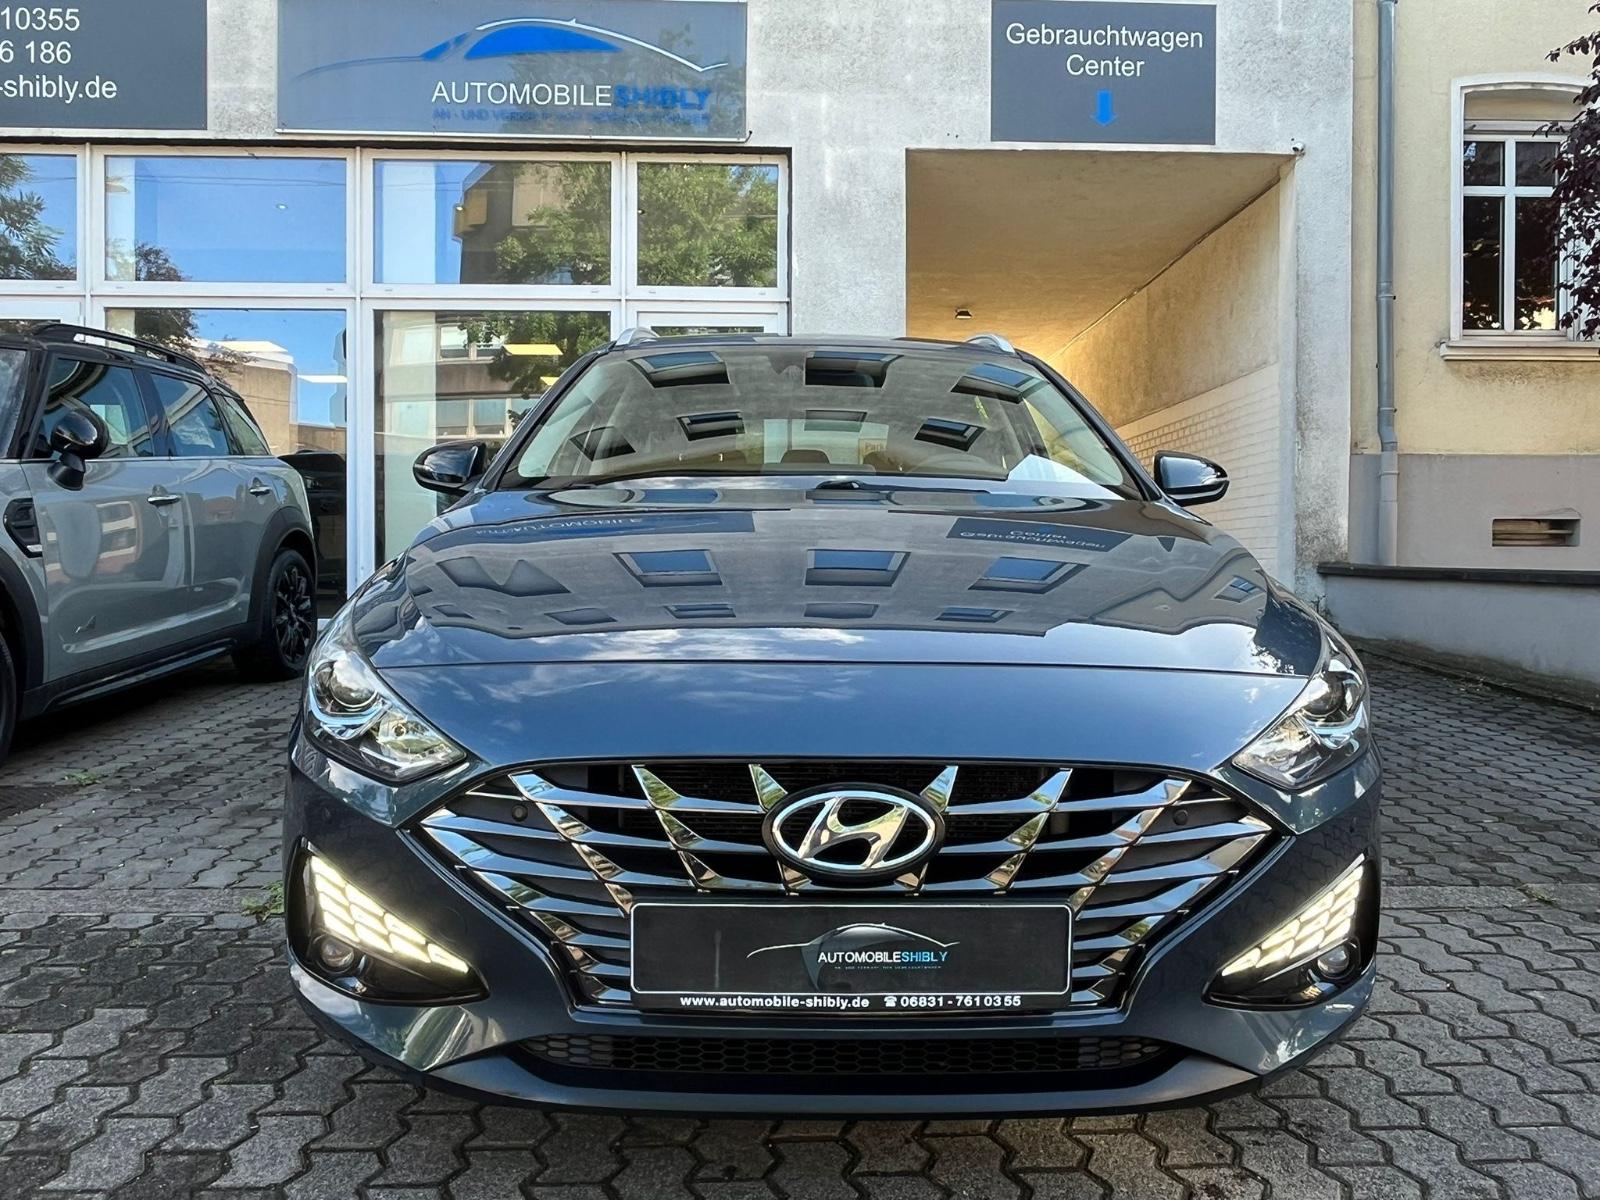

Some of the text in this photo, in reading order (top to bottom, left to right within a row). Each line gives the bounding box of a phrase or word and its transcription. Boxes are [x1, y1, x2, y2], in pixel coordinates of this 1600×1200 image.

[0, 7, 80, 32] 10355
[1006, 22, 1204, 52] Gebrauchtwagen
[0, 40, 72, 64] 6 186
[1066, 53, 1145, 77] Center
[680, 996, 870, 1010] www.automobile-shibly.de
[900, 995, 944, 1007] 06831
